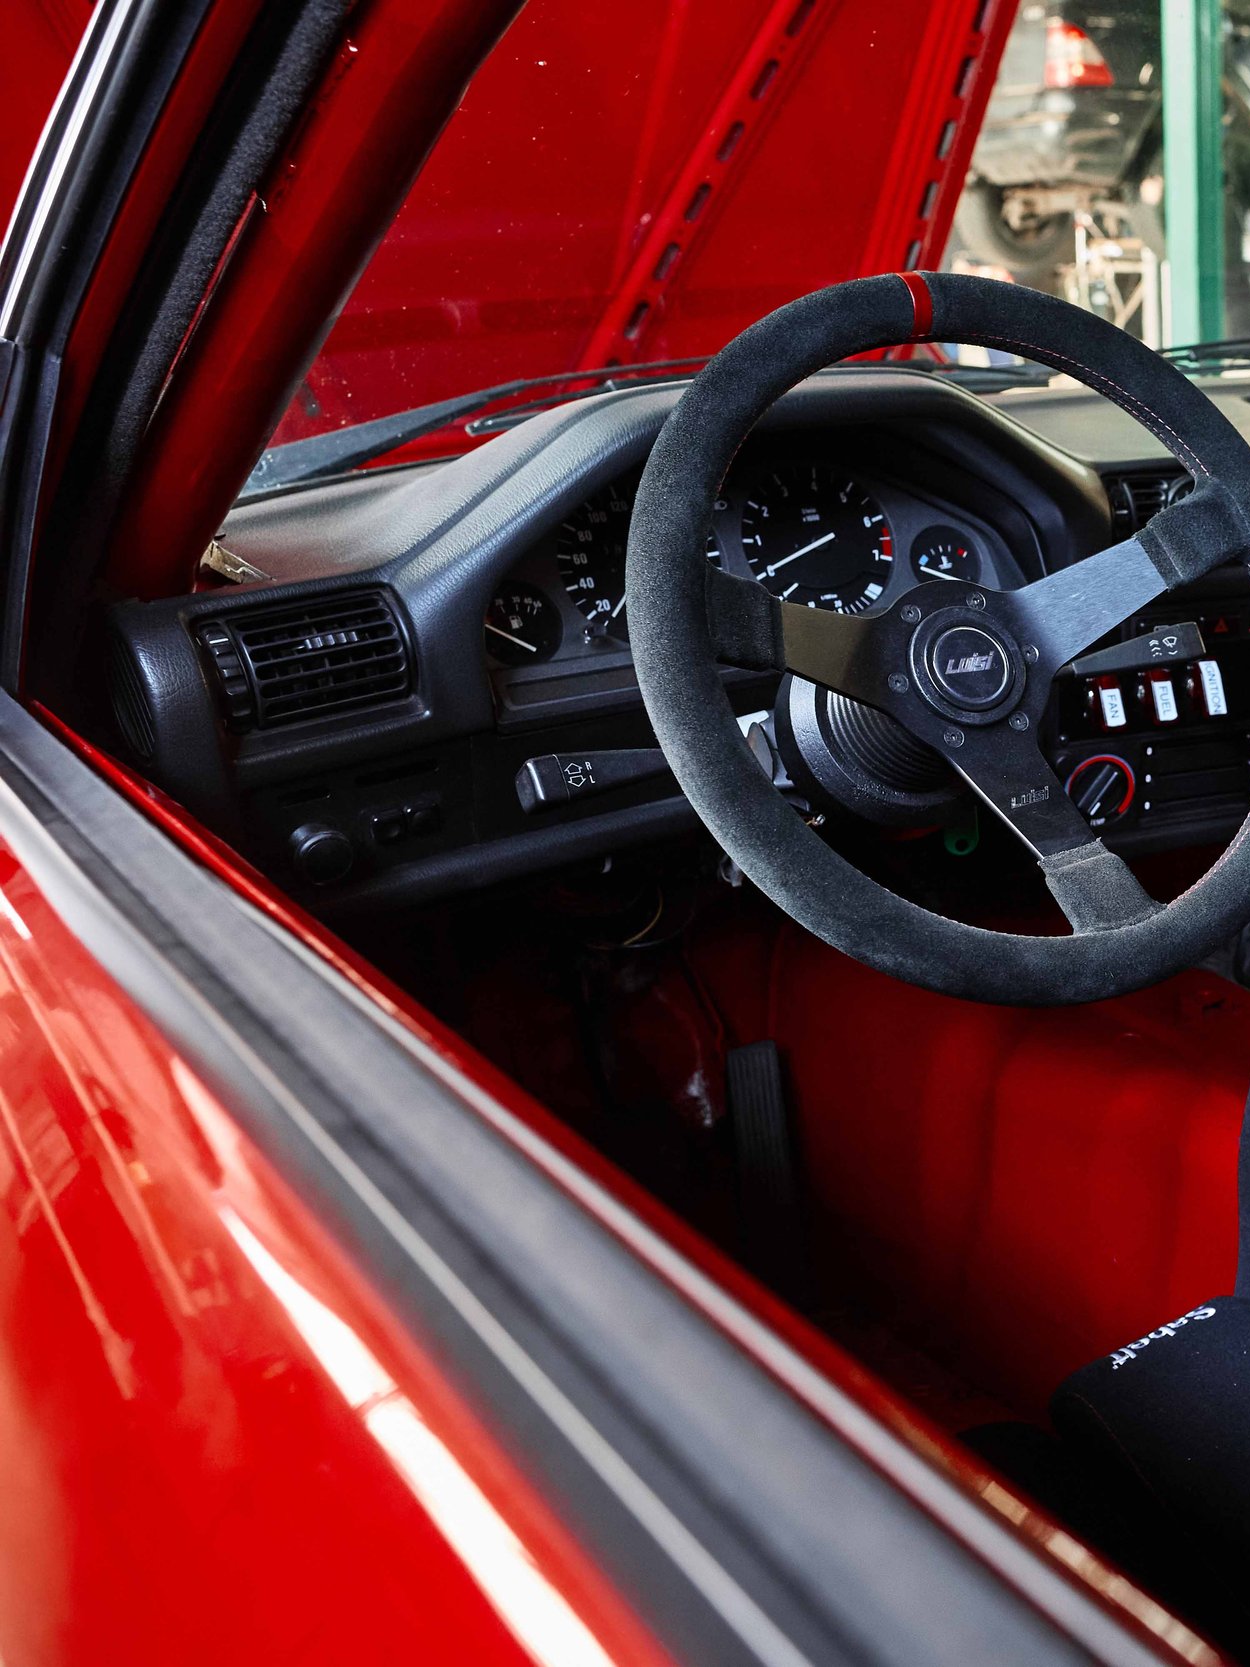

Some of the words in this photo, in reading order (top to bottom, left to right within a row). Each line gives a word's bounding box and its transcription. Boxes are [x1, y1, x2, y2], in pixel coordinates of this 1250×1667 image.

[839, 492, 847, 503] 5
[587, 511, 608, 523] 100
[761, 506, 770, 517] 2
[863, 516, 872, 528] 6
[577, 529, 593, 542] 80
[754, 535, 762, 546] 1
[572, 553, 588, 565] 60
[872, 549, 880, 561] 7
[579, 577, 595, 589] 40
[595, 599, 611, 612] 20
[945, 651, 996, 675] Luisi
[1205, 662, 1223, 714] IGNITION
[1159, 685, 1173, 715] FUEL
[1107, 694, 1120, 719] FAN
[585, 761, 592, 771] R
[589, 775, 596, 784] L
[1011, 786, 1050, 809] Luisi
